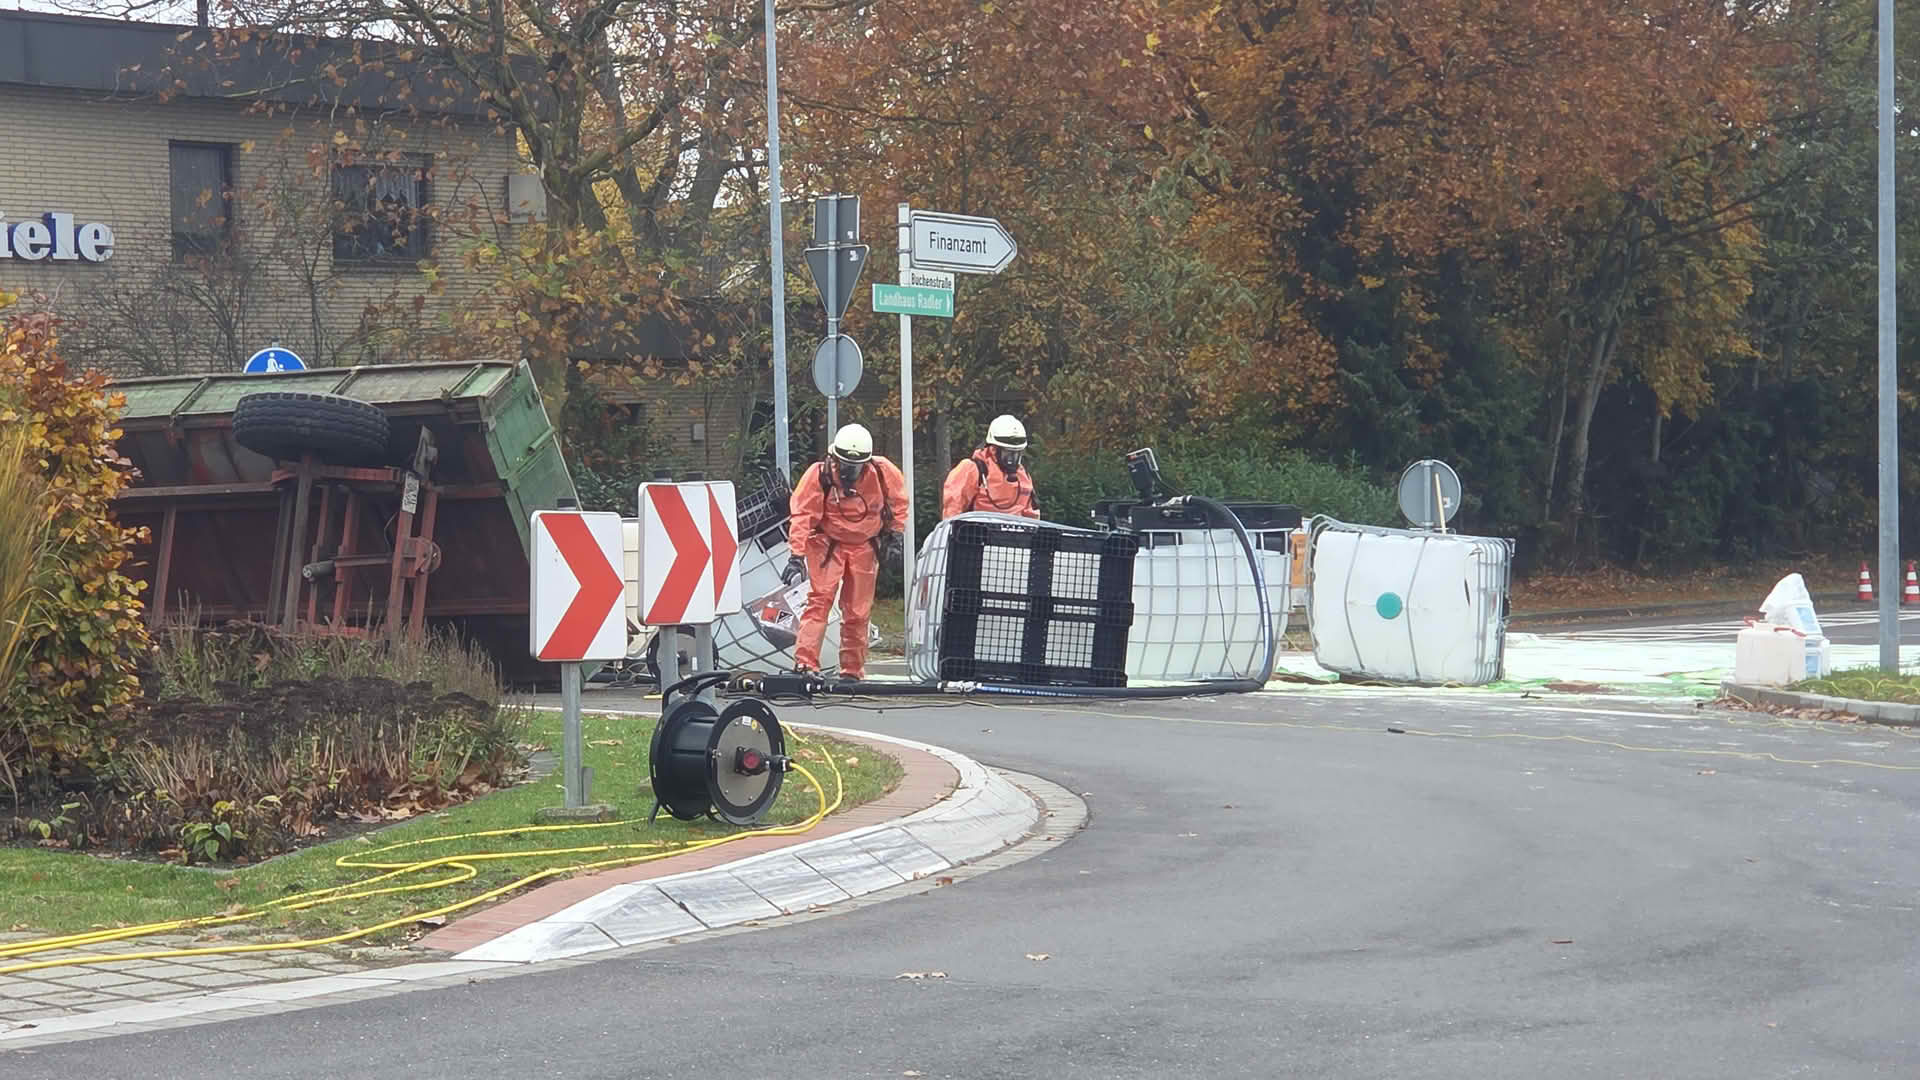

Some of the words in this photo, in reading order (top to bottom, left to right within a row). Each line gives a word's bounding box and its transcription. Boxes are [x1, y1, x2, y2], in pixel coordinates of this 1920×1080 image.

[929, 231, 987, 254] Finanzamt
[911, 272, 952, 289] Buchenstraße
[879, 291, 915, 308] Landhaus
